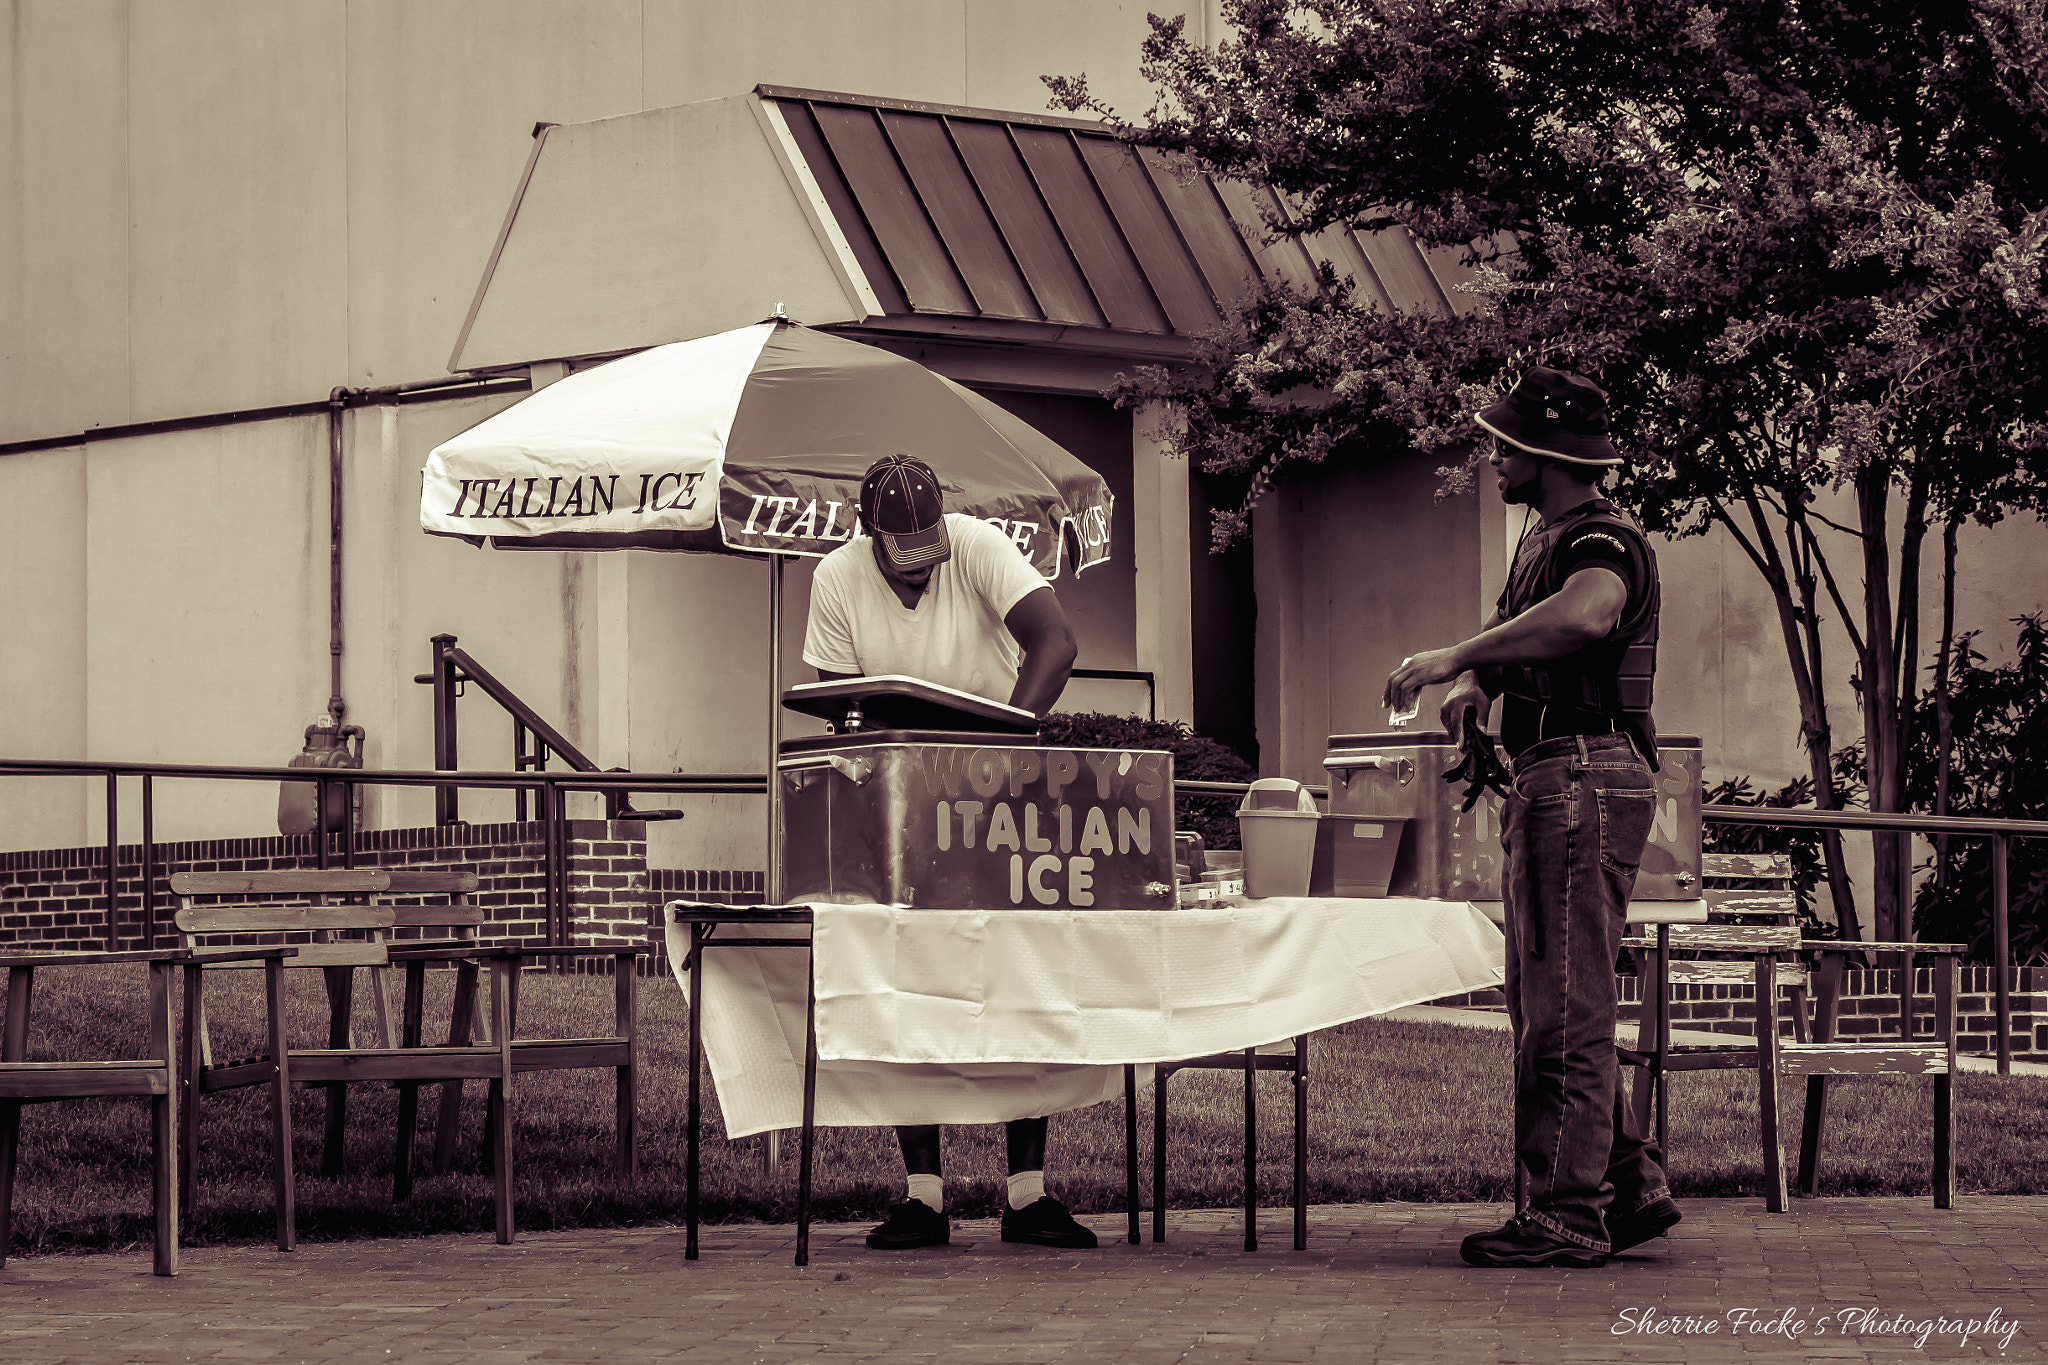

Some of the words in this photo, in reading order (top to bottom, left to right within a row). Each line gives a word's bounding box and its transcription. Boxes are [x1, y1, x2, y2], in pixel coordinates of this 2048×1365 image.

[446, 474, 620, 519] ITALIAN
[631, 471, 706, 514] ICE
[920, 747, 1164, 800] WOPPY'S
[936, 800, 1151, 856] ITALIAN
[1009, 853, 1095, 907] ICE
